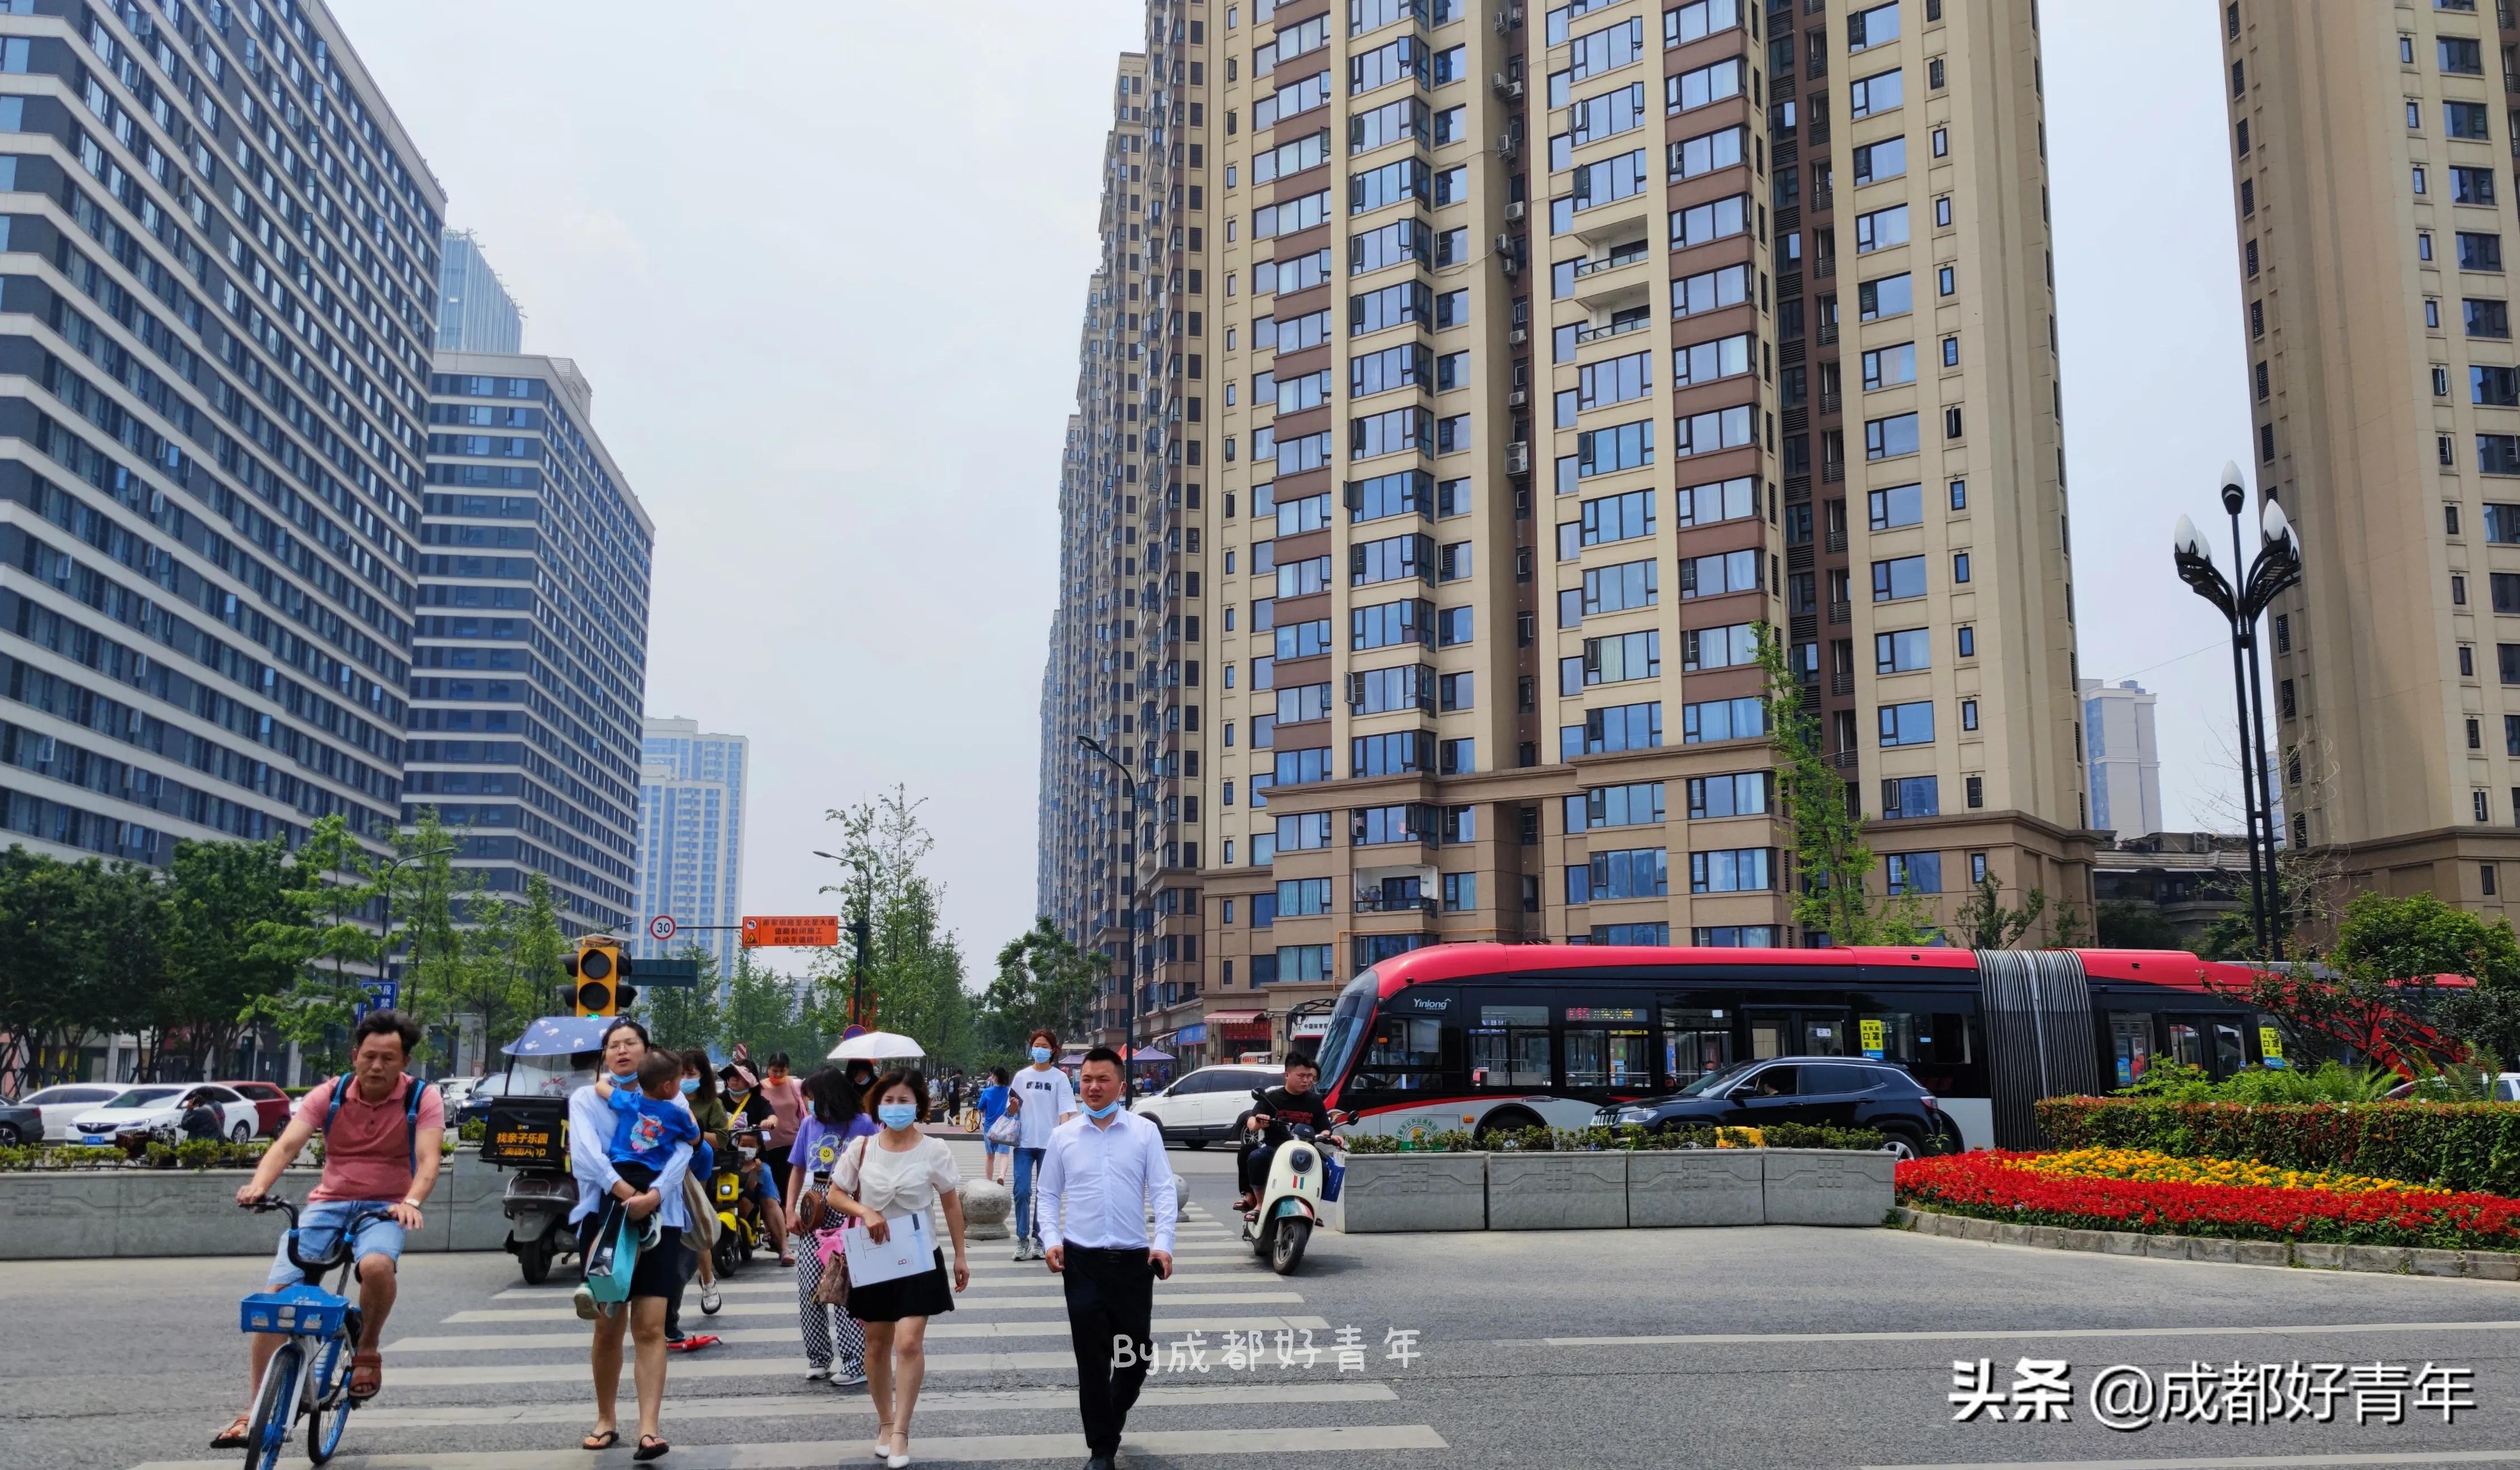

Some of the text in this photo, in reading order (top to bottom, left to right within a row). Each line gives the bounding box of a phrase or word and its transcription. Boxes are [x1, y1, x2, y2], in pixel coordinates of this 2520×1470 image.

[657, 923, 670, 933] 30
[1414, 999, 1447, 1009] Yinlong
[497, 1132, 549, 1144] 找亲子乐园
